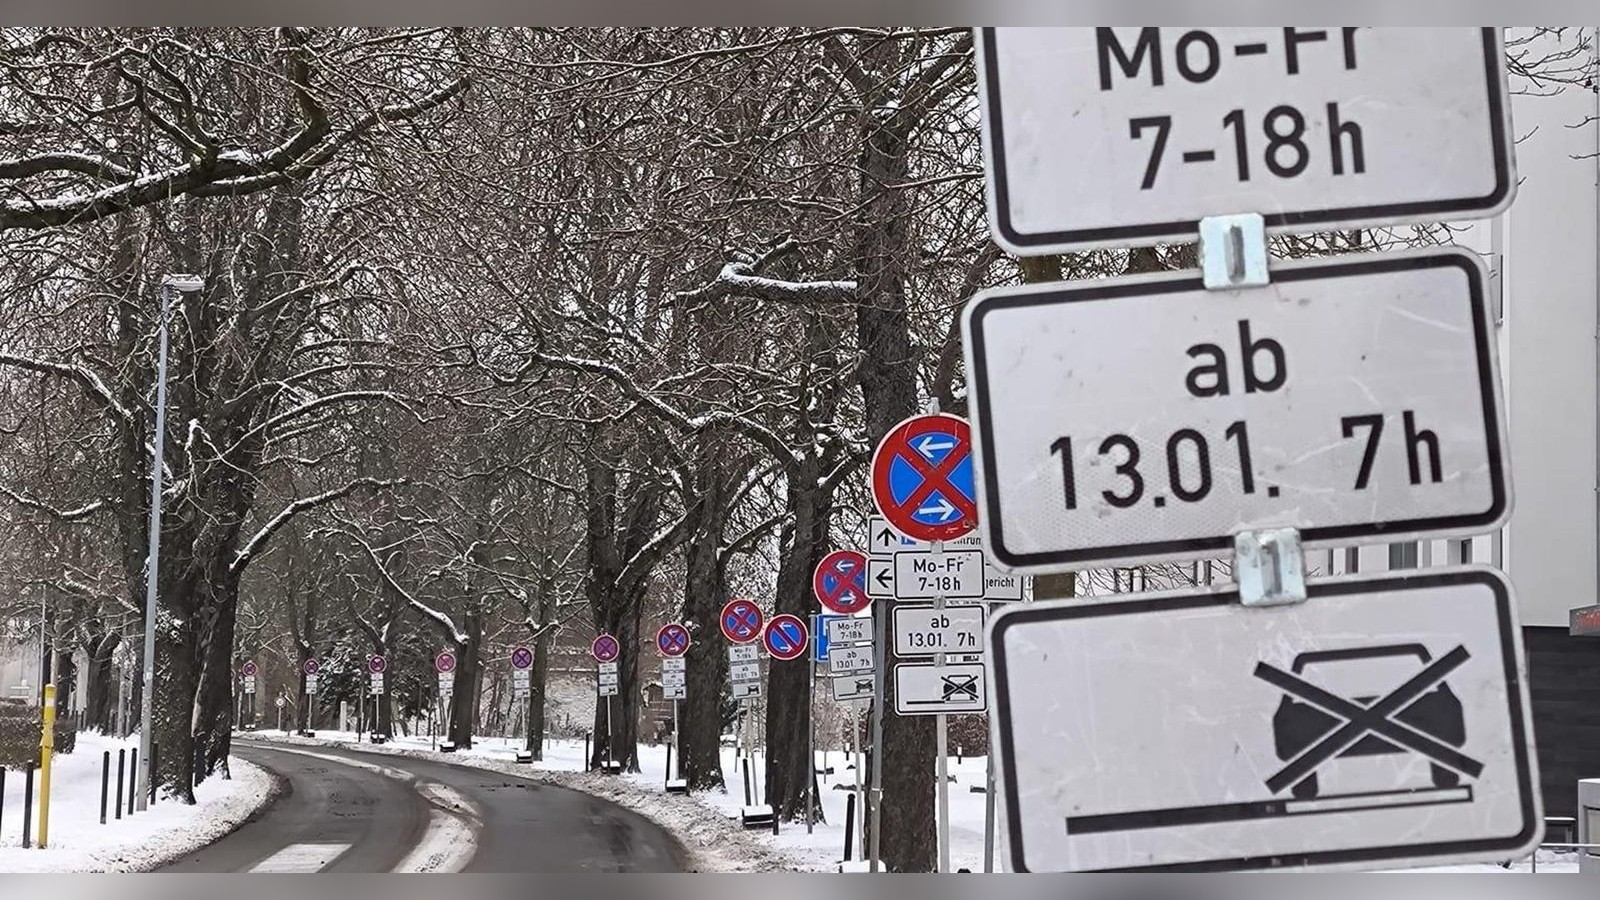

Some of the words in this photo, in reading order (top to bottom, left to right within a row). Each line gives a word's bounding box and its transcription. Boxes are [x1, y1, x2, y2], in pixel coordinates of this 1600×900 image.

[1096, 27, 1372, 90] Mo-Fr
[1185, 319, 1287, 398] ab
[1049, 420, 1281, 510] 13.01.
[1340, 410, 1443, 491] 7h
[913, 558, 963, 573] Mo-Fr
[837, 621, 864, 630] Mo-Fr
[930, 614, 950, 628] ab
[908, 632, 947, 648] 13.01.
[957, 632, 976, 647] 7h
[846, 651, 857, 659] ab
